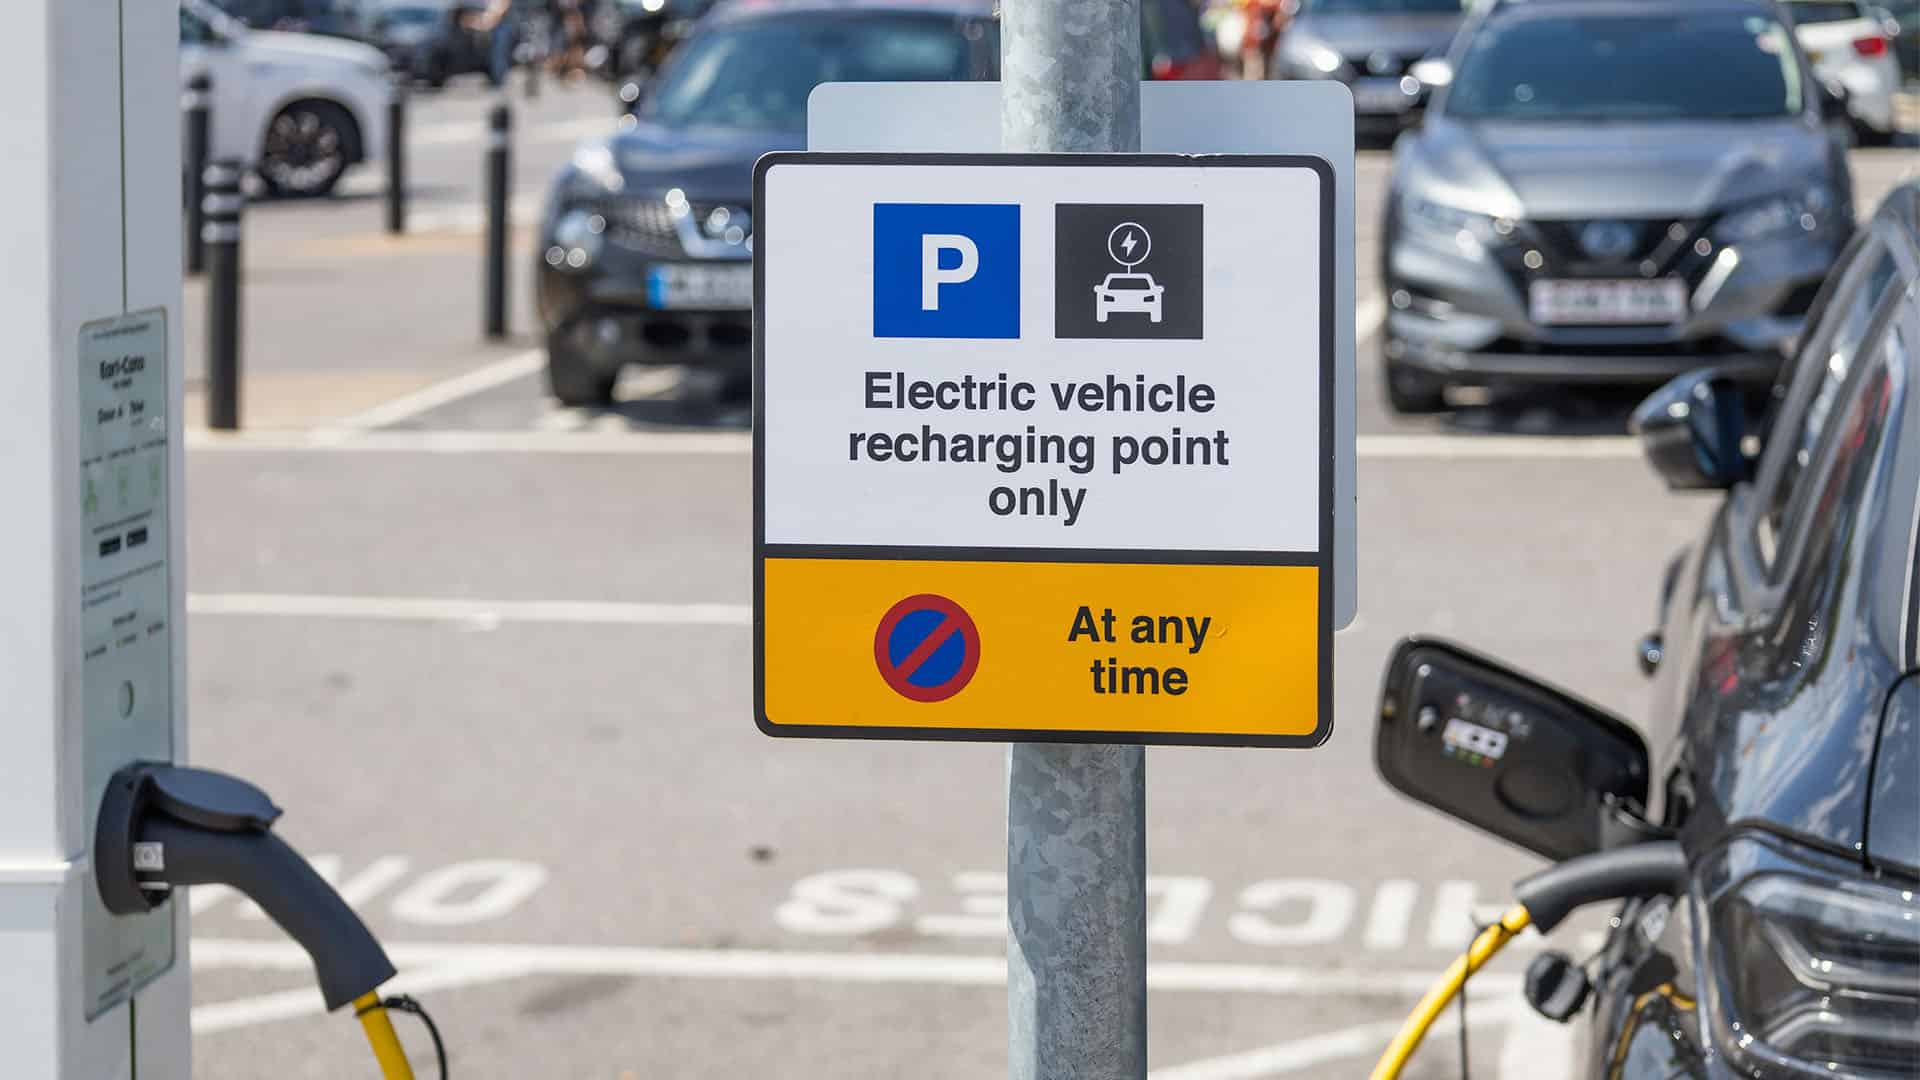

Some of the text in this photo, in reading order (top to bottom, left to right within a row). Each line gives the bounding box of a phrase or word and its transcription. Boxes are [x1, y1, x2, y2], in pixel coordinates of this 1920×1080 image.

[922, 234, 979, 311] P
[865, 371, 1216, 413] Electric vehicle
[849, 424, 1230, 475] recharging point
[988, 478, 1087, 527] only
[1068, 606, 1211, 654] At any
[1090, 657, 1188, 696] time
